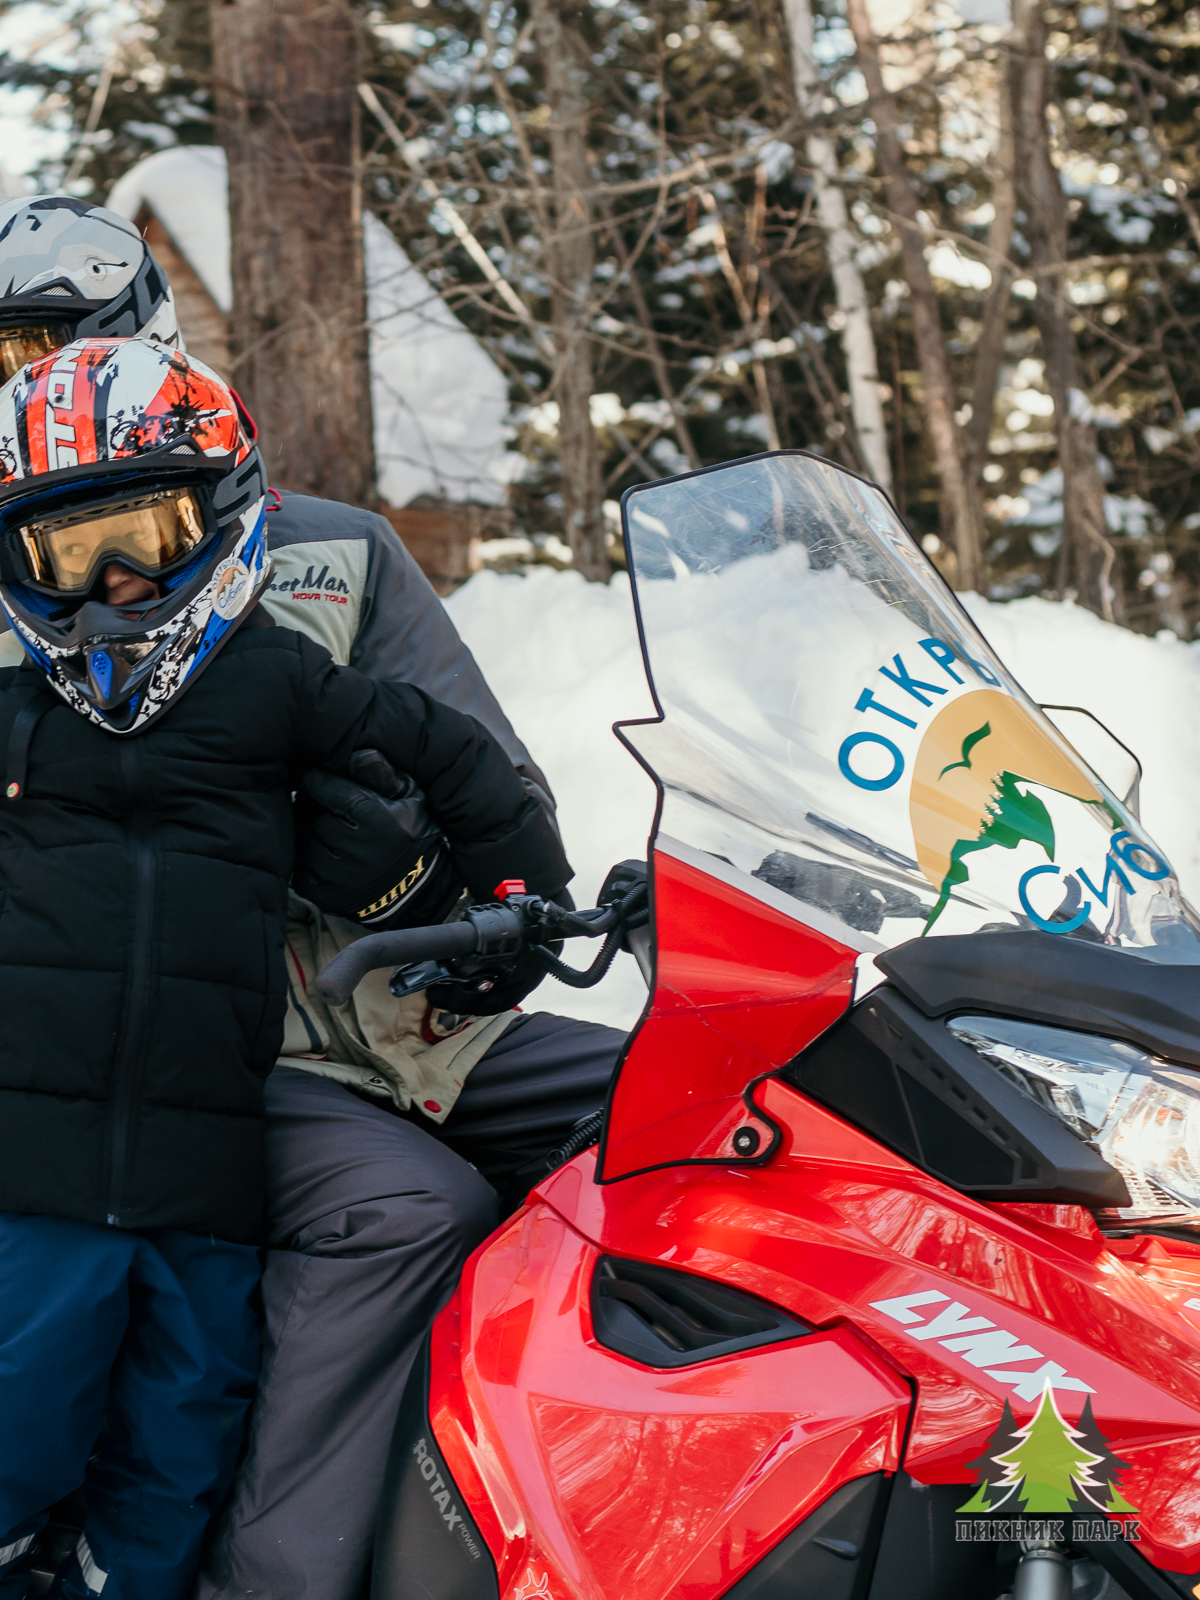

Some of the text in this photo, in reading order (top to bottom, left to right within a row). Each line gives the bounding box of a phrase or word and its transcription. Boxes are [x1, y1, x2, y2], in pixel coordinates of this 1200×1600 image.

[292, 592, 348, 605] NOVA TOUR
[868, 1289, 1098, 1403] LYNX
[413, 1438, 481, 1560] ROTAX POWER
